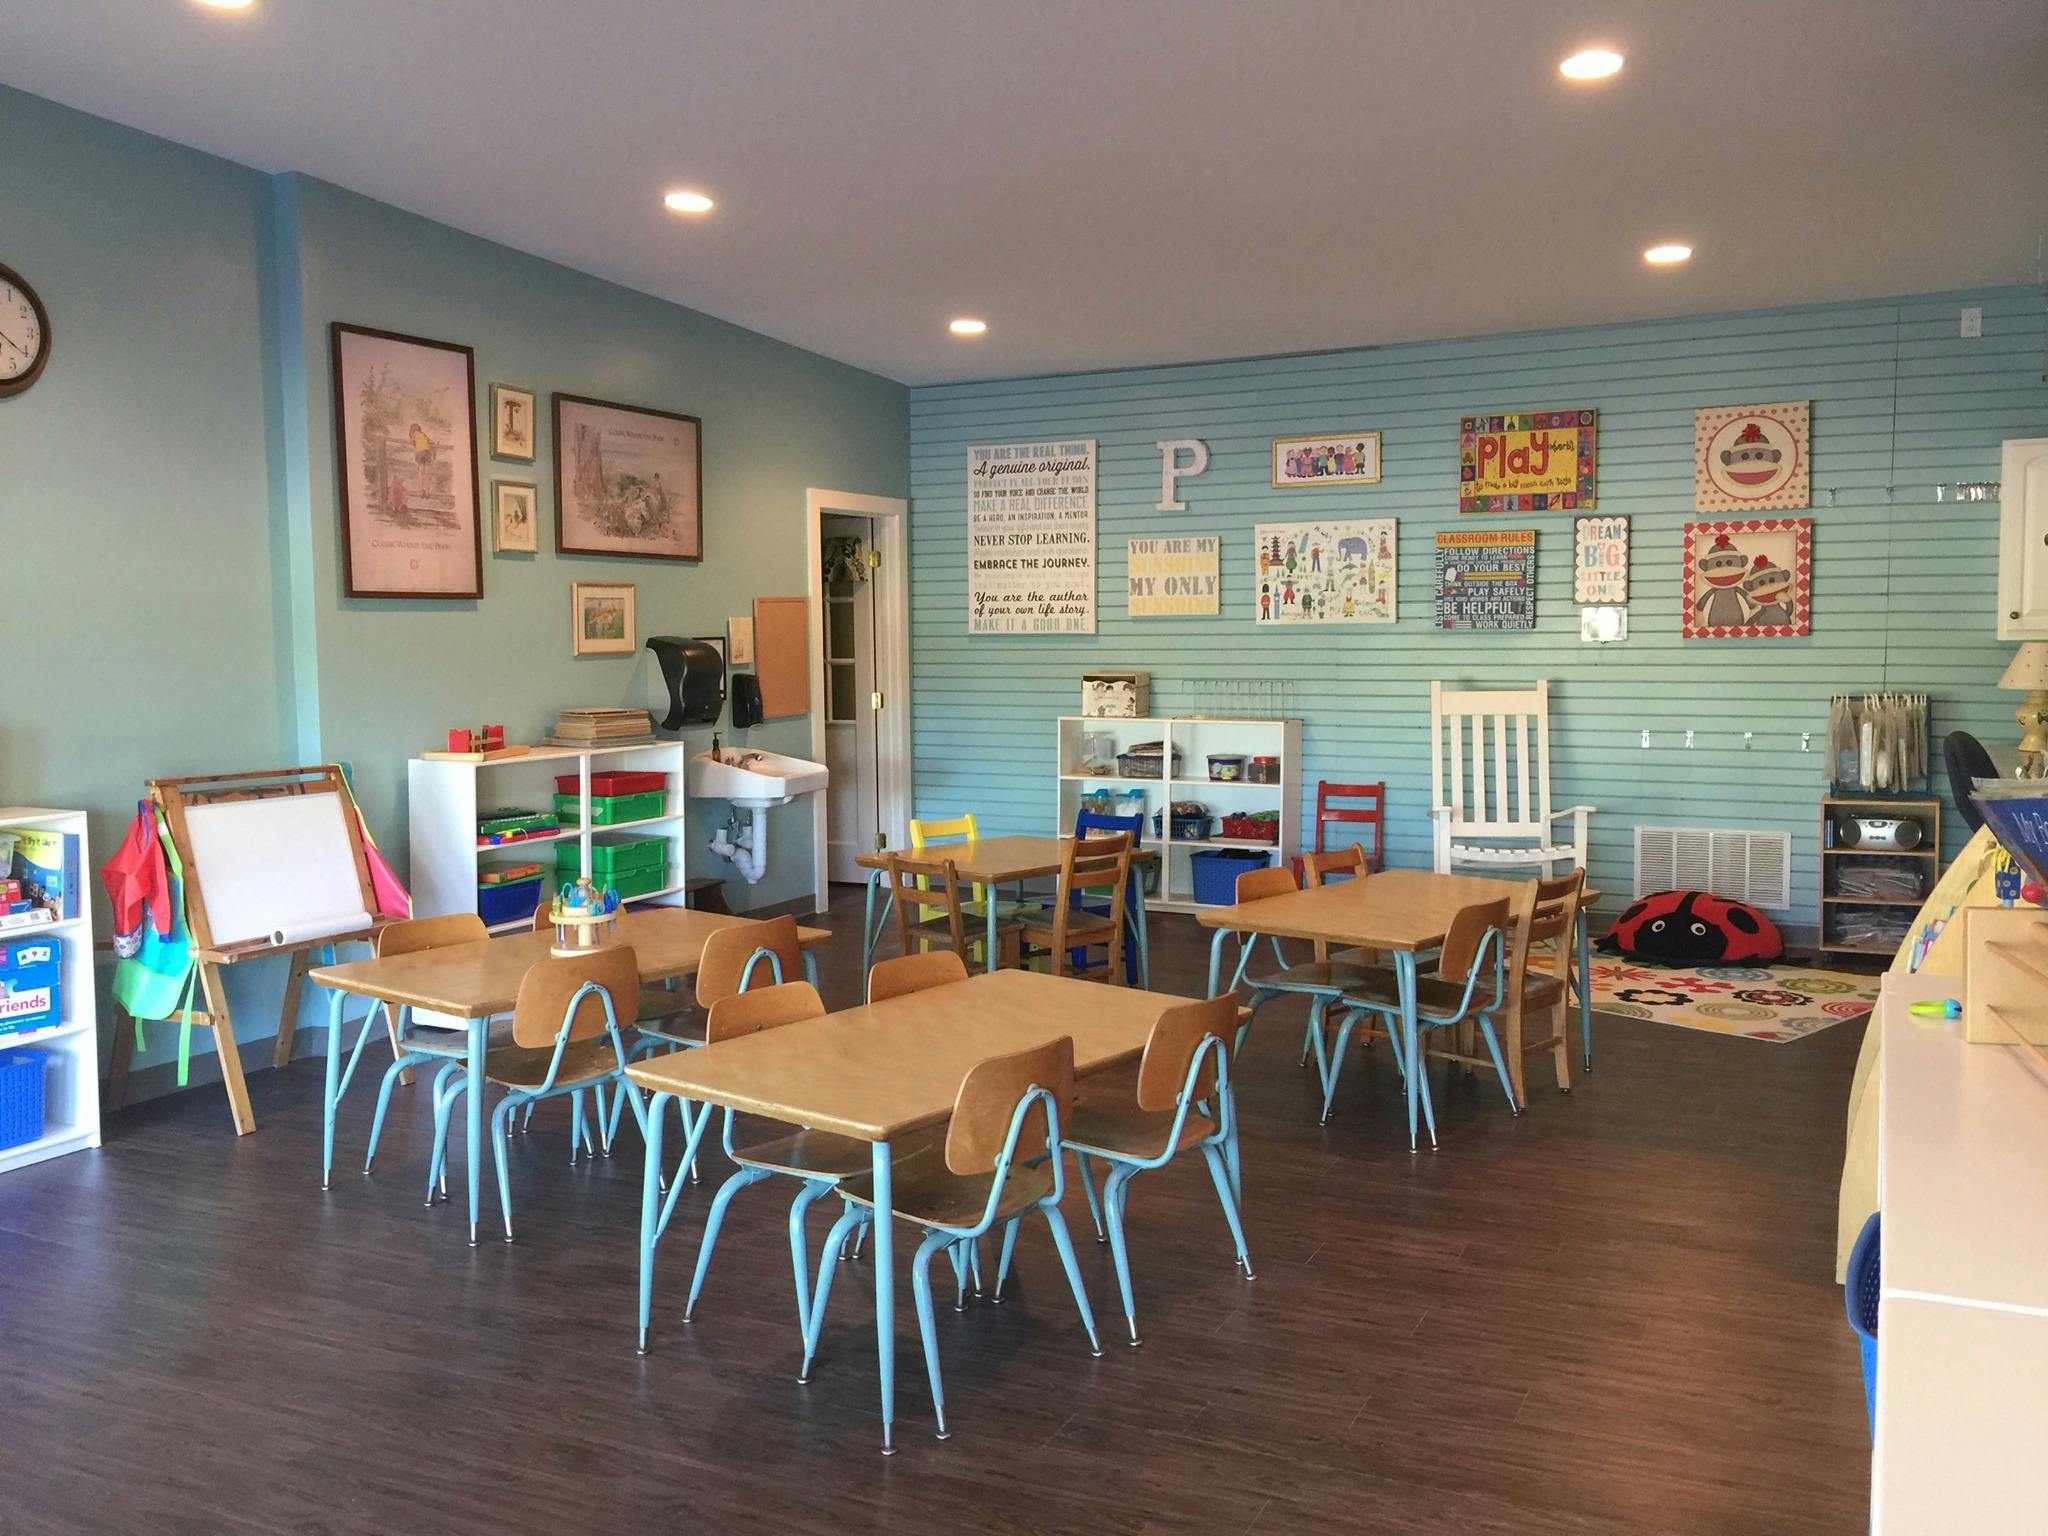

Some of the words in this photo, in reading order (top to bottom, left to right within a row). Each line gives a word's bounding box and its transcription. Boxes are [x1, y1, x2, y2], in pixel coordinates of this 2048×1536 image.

[20, 305, 27, 319] 2
[27, 327, 34, 340] 3
[9, 358, 16, 370] 5
[974, 449, 991, 460] YOU
[994, 448, 1012, 460] ARE
[1014, 446, 1030, 458] THE
[1033, 445, 1056, 458] REAL
[1478, 432, 1549, 479] Play
[973, 460, 988, 477] A
[989, 461, 1036, 480] genuine
[1038, 456, 1090, 476] original.
[1156, 439, 1210, 511] P
[1058, 486, 1069, 495] THE
[1071, 486, 1090, 494] WORLD
[974, 499, 996, 512] MAKE
[1000, 499, 1006, 512] A
[1009, 498, 1030, 511] REAL
[1034, 495, 1088, 510] DIFFERENCE
[974, 514, 980, 522] BE
[982, 514, 987, 522] A
[1008, 513, 1016, 521] AN
[1058, 512, 1062, 520] A
[1064, 510, 1089, 520] MENTOR
[974, 534, 1005, 546] NEVER
[1008, 534, 1032, 546] STOP
[1036, 532, 1090, 545] LEARNING.
[1437, 534, 1498, 544] CLASSROOM
[1501, 532, 1534, 542] RULES
[1583, 525, 1621, 540] DREAM
[1130, 540, 1159, 554] YOU
[1164, 540, 1192, 554] ARE
[1196, 539, 1216, 552] MY
[1444, 548, 1479, 556] FOLLOW
[1482, 546, 1535, 555] DIRECTIONS
[1584, 543, 1620, 567] BIG
[974, 559, 1018, 570] EMBRACE
[1020, 558, 1040, 569] THE
[1042, 557, 1090, 568] JOURNEY.
[1474, 564, 1498, 572] YOUR
[1503, 564, 1526, 572] BEST
[1526, 555, 1535, 584] OTHERS
[1436, 548, 1444, 596] CAREFULLY
[1130, 577, 1156, 596] MY
[1164, 576, 1217, 596] ONLY
[1468, 588, 1490, 596] PLAY
[1493, 587, 1525, 596] SAFELY
[974, 591, 1000, 606] You
[1003, 594, 1024, 602] are
[1027, 590, 1045, 602] the
[1049, 590, 1089, 602] author
[1526, 588, 1534, 620] RESPECT
[974, 603, 986, 618] of
[988, 606, 1012, 618] your
[1015, 606, 1034, 615] own
[1038, 603, 1056, 618] life
[1058, 604, 1090, 617] story.
[1444, 602, 1458, 614] BE
[1463, 602, 1514, 614] HELPFUL
[974, 618, 1000, 630] MAKE
[1021, 619, 1027, 630] A
[1034, 618, 1060, 630] GOOD
[1476, 620, 1498, 628] WORK
[1502, 620, 1534, 628] QUIETLY
[2012, 812, 2042, 852] My
[0, 995, 46, 1014] riends
